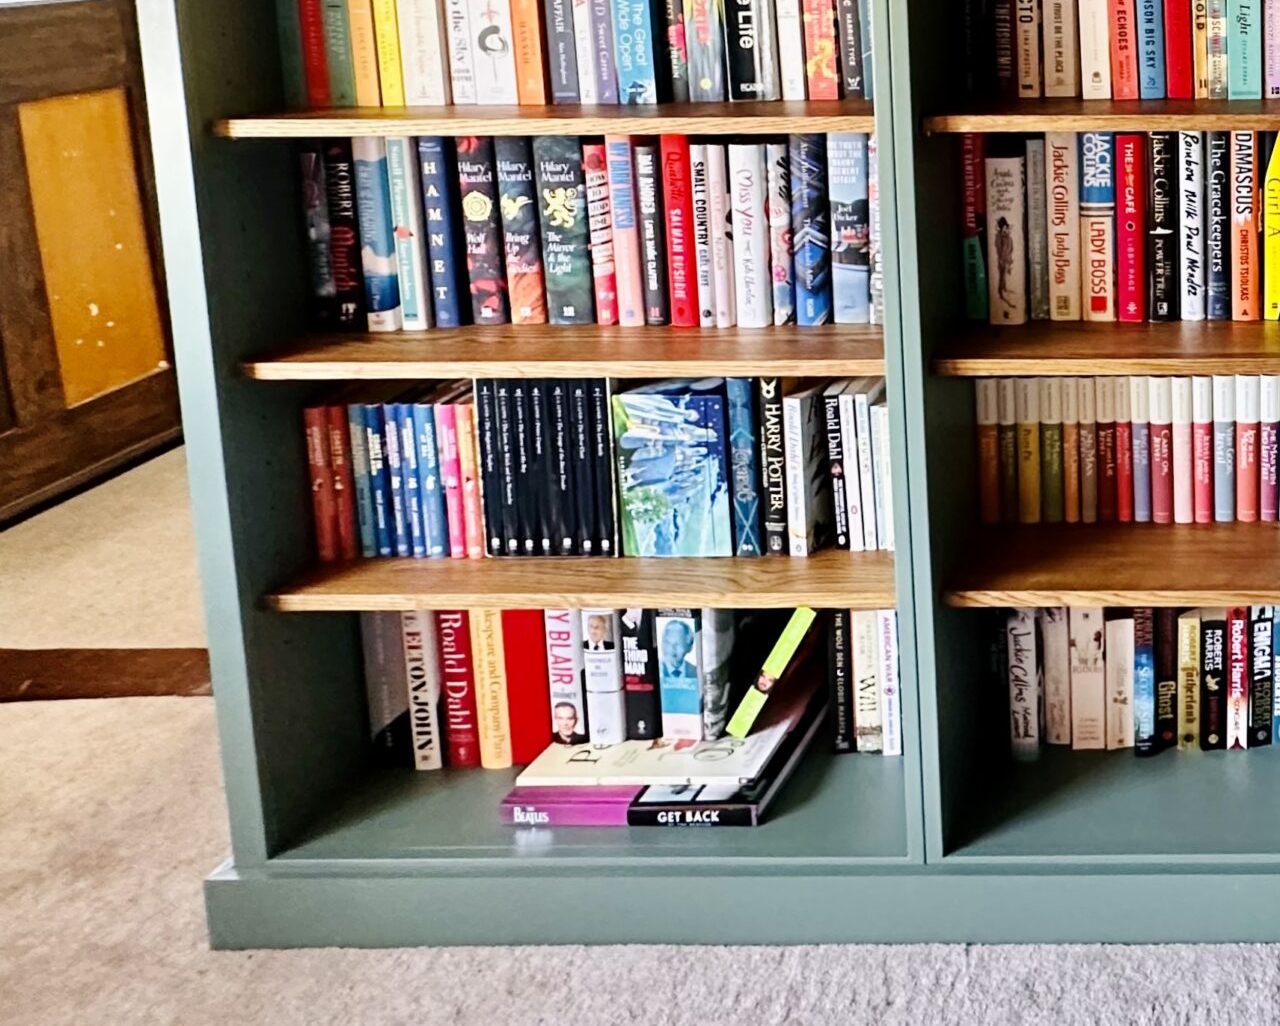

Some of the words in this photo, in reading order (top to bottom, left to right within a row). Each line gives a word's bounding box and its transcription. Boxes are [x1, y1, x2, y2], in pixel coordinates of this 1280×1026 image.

[633, 3, 645, 26] The
[737, 11, 756, 49] Life
[1235, 5, 1250, 35] Light
[619, 33, 635, 71] Open
[634, 28, 648, 67] Great
[1144, 29, 1155, 46] BIG
[1145, 51, 1156, 69] SKY
[1082, 134, 1098, 187] COLLINS
[1094, 134, 1111, 187] JACKIE
[1150, 132, 1169, 175] Jackie
[1182, 132, 1200, 182] Rainbow
[1210, 136, 1225, 166] The
[693, 161, 706, 194] SMALL
[1234, 133, 1253, 215] DAMASCUS
[1153, 178, 1171, 222] Collins
[1183, 190, 1200, 220] Milk
[423, 161, 448, 299] HAMNET
[695, 199, 708, 246] COUNTRY
[1090, 221, 1106, 256] LADY
[1185, 226, 1200, 252] Paul
[1209, 170, 1226, 272] Gracekeepers
[1239, 229, 1249, 265] CHRISTOS
[1091, 259, 1107, 295] BOSS
[1186, 257, 1200, 297] Mendez
[1239, 268, 1250, 301] TSIOLKAS
[764, 403, 783, 452] HARRY
[824, 398, 840, 430] Roald
[827, 433, 842, 459] Dahl
[768, 456, 785, 511] POTTER
[439, 613, 467, 673] Roald
[549, 630, 571, 685] BLAIR
[882, 617, 893, 662] AMERICAN
[1204, 629, 1214, 671] HARRIS
[1212, 629, 1223, 670] ROBERT
[1231, 619, 1245, 660] Robert
[1253, 621, 1272, 681] ENIGMA
[405, 631, 427, 692] ELTON
[885, 664, 894, 682] WAR
[1231, 662, 1245, 698] Harris
[446, 680, 472, 729] Dahl
[859, 675, 876, 712] Will
[1157, 681, 1176, 720] Ghost
[413, 694, 433, 751] JOHN
[657, 811, 681, 824] GET
[685, 810, 720, 823] BACK
